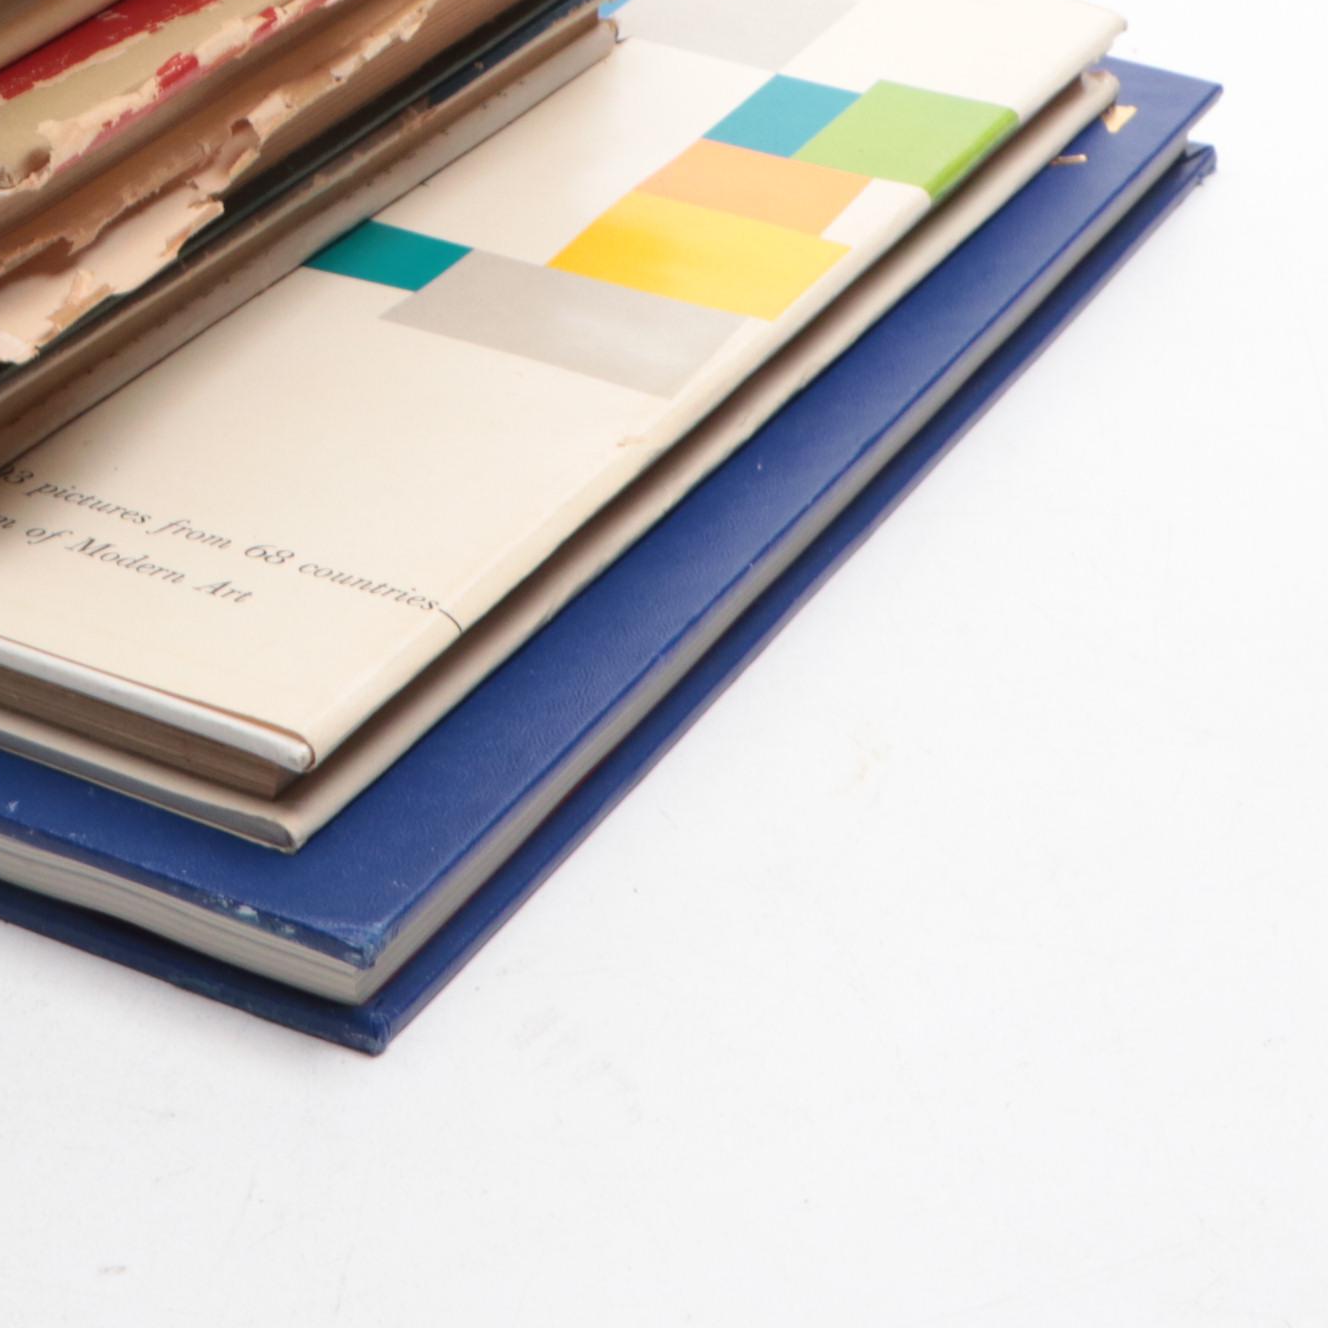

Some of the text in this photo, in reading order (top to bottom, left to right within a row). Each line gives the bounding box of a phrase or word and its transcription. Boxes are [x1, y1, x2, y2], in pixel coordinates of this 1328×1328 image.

[24, 481, 152, 524] pictures
[144, 518, 233, 550] from
[243, 544, 296, 566] 68
[25, 526, 75, 545] of
[63, 535, 187, 585] Modern
[192, 579, 254, 604] Art
